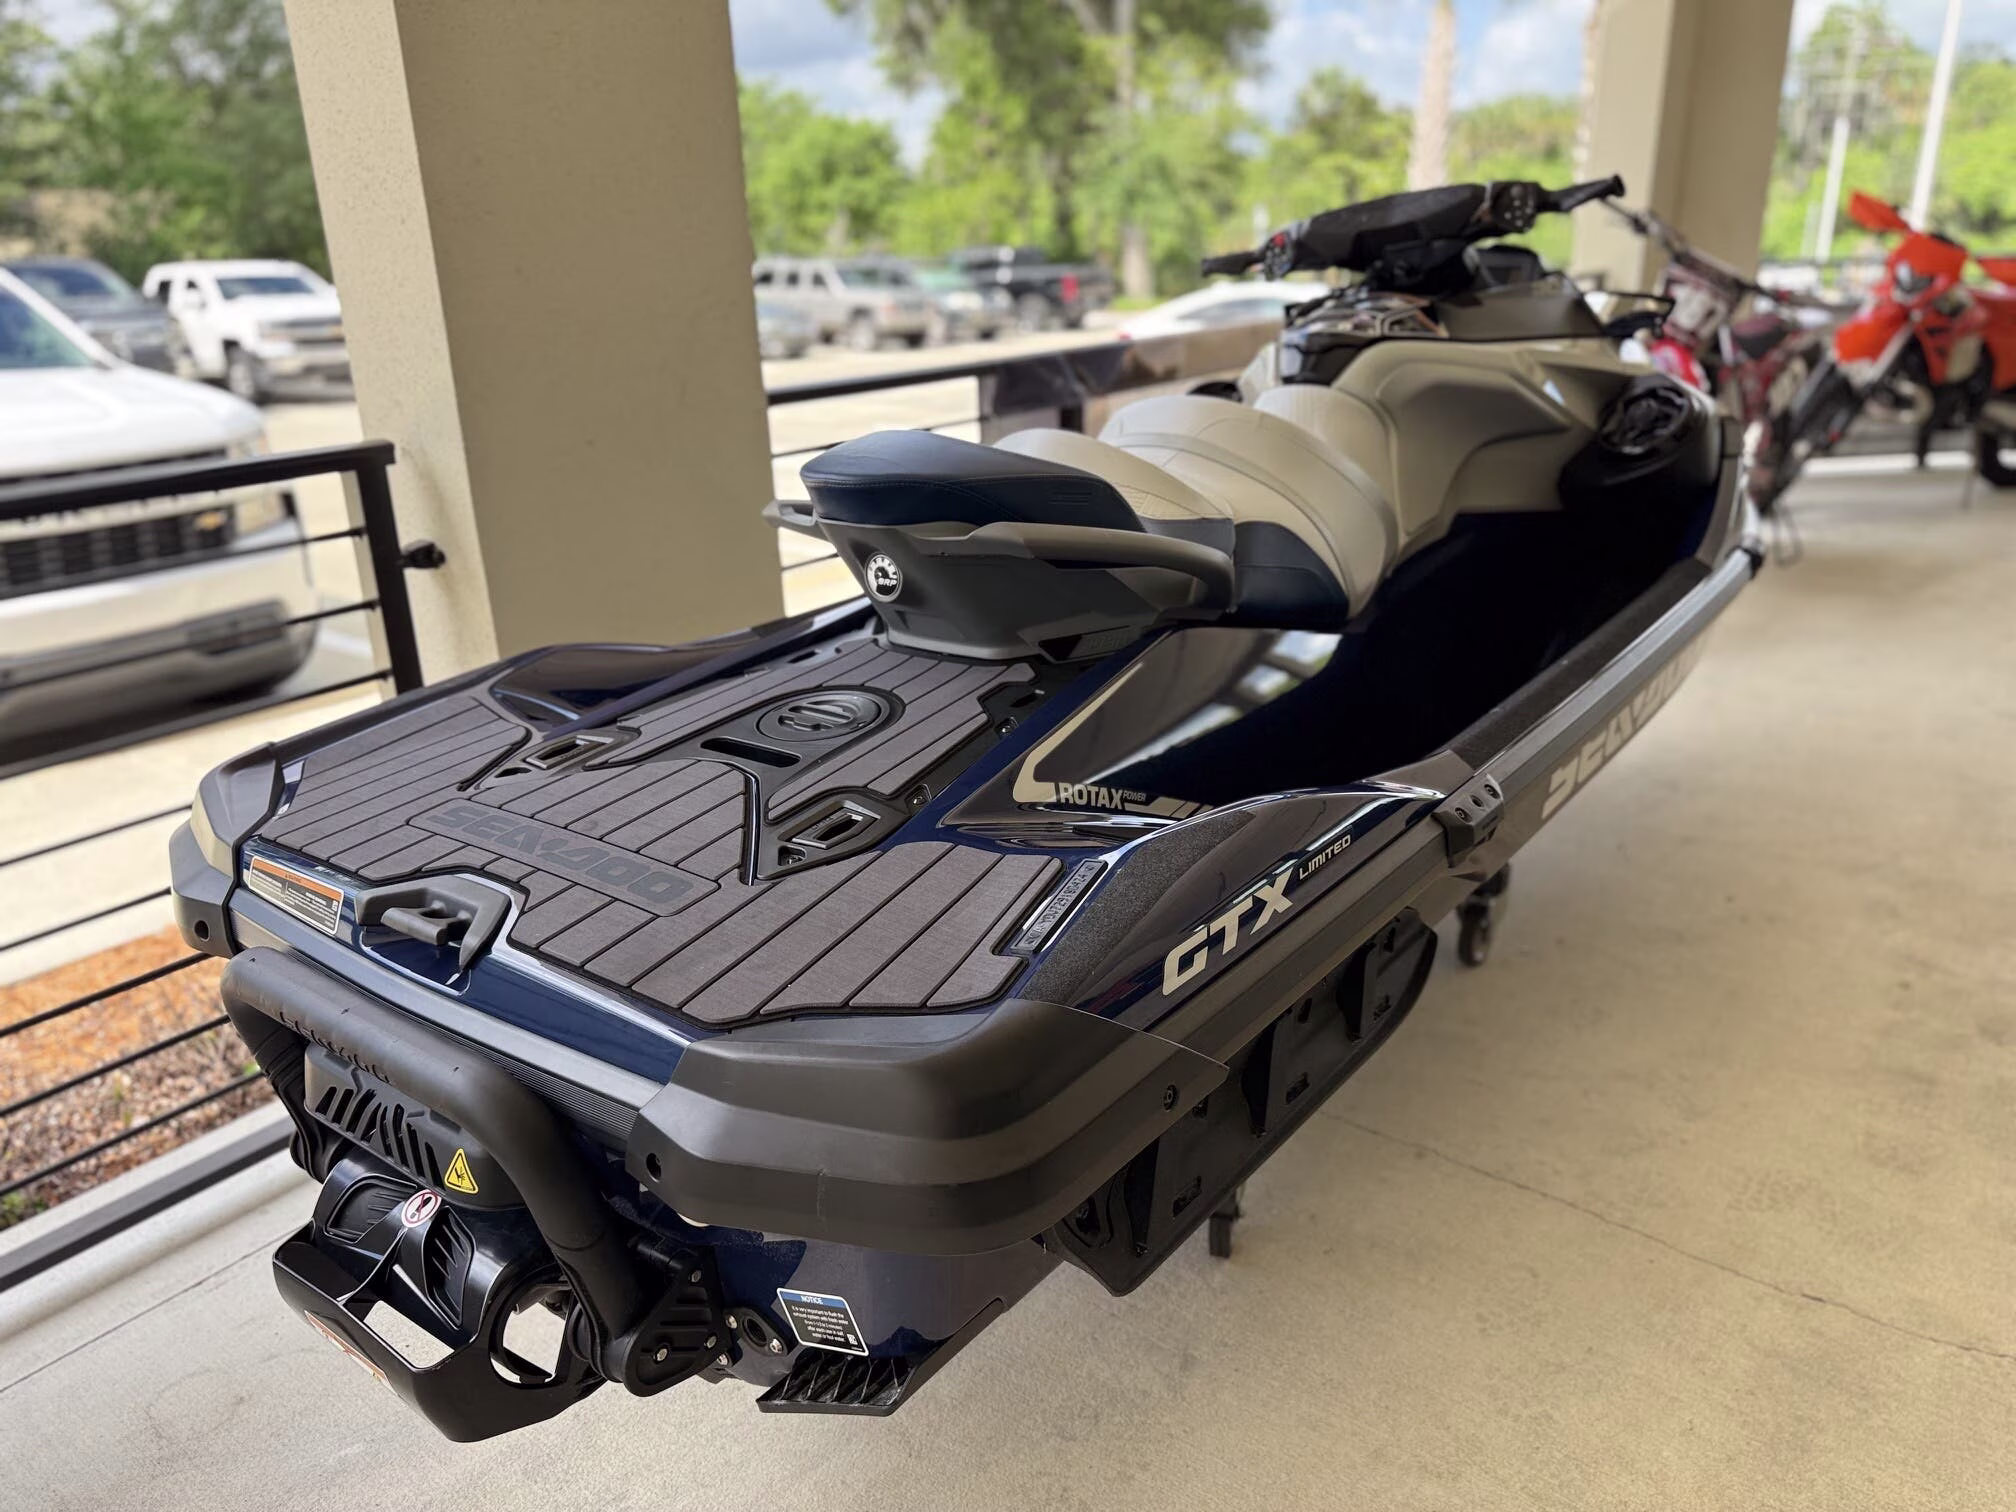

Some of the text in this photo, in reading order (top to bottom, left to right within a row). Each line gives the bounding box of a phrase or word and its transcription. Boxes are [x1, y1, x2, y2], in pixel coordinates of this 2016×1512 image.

[878, 578, 898, 587] BRP
[1058, 782, 1147, 810] ROTAX POWER
[1162, 834, 1351, 996] GTX LIMITED
[800, 1295, 824, 1305] NOTICE
